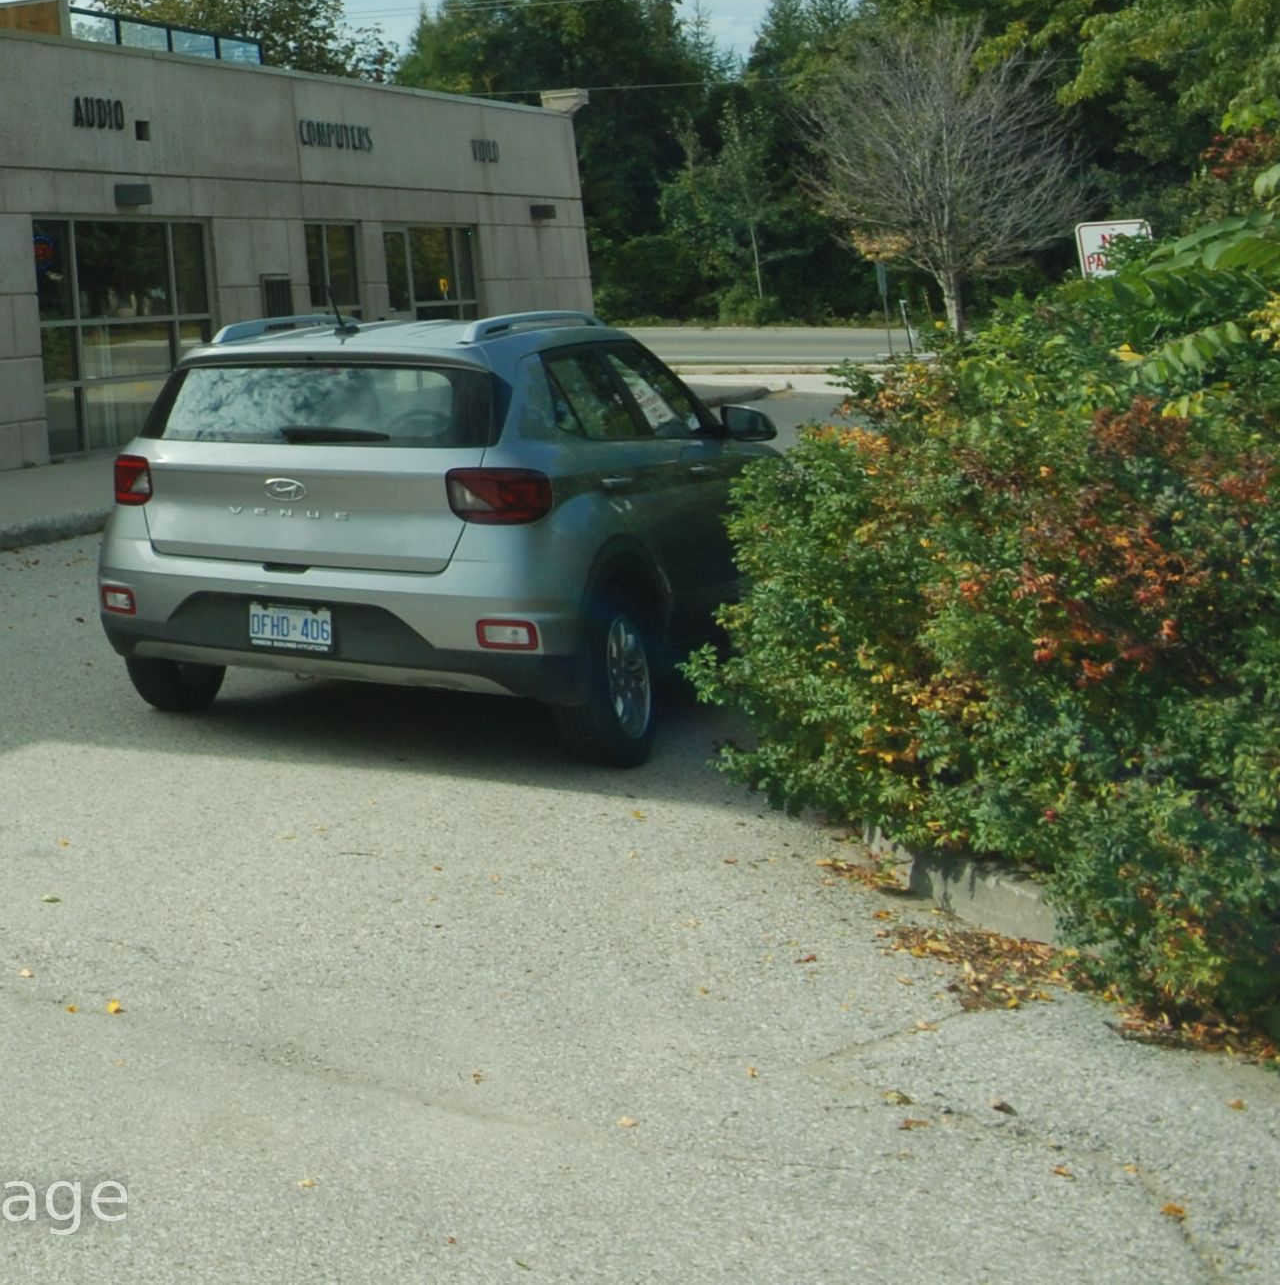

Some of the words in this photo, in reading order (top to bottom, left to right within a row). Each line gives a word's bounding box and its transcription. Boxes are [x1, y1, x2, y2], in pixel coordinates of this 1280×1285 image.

[73, 96, 124, 130] AUDIO
[300, 119, 373, 152] COMPUTERS
[228, 506, 350, 521] VENUE
